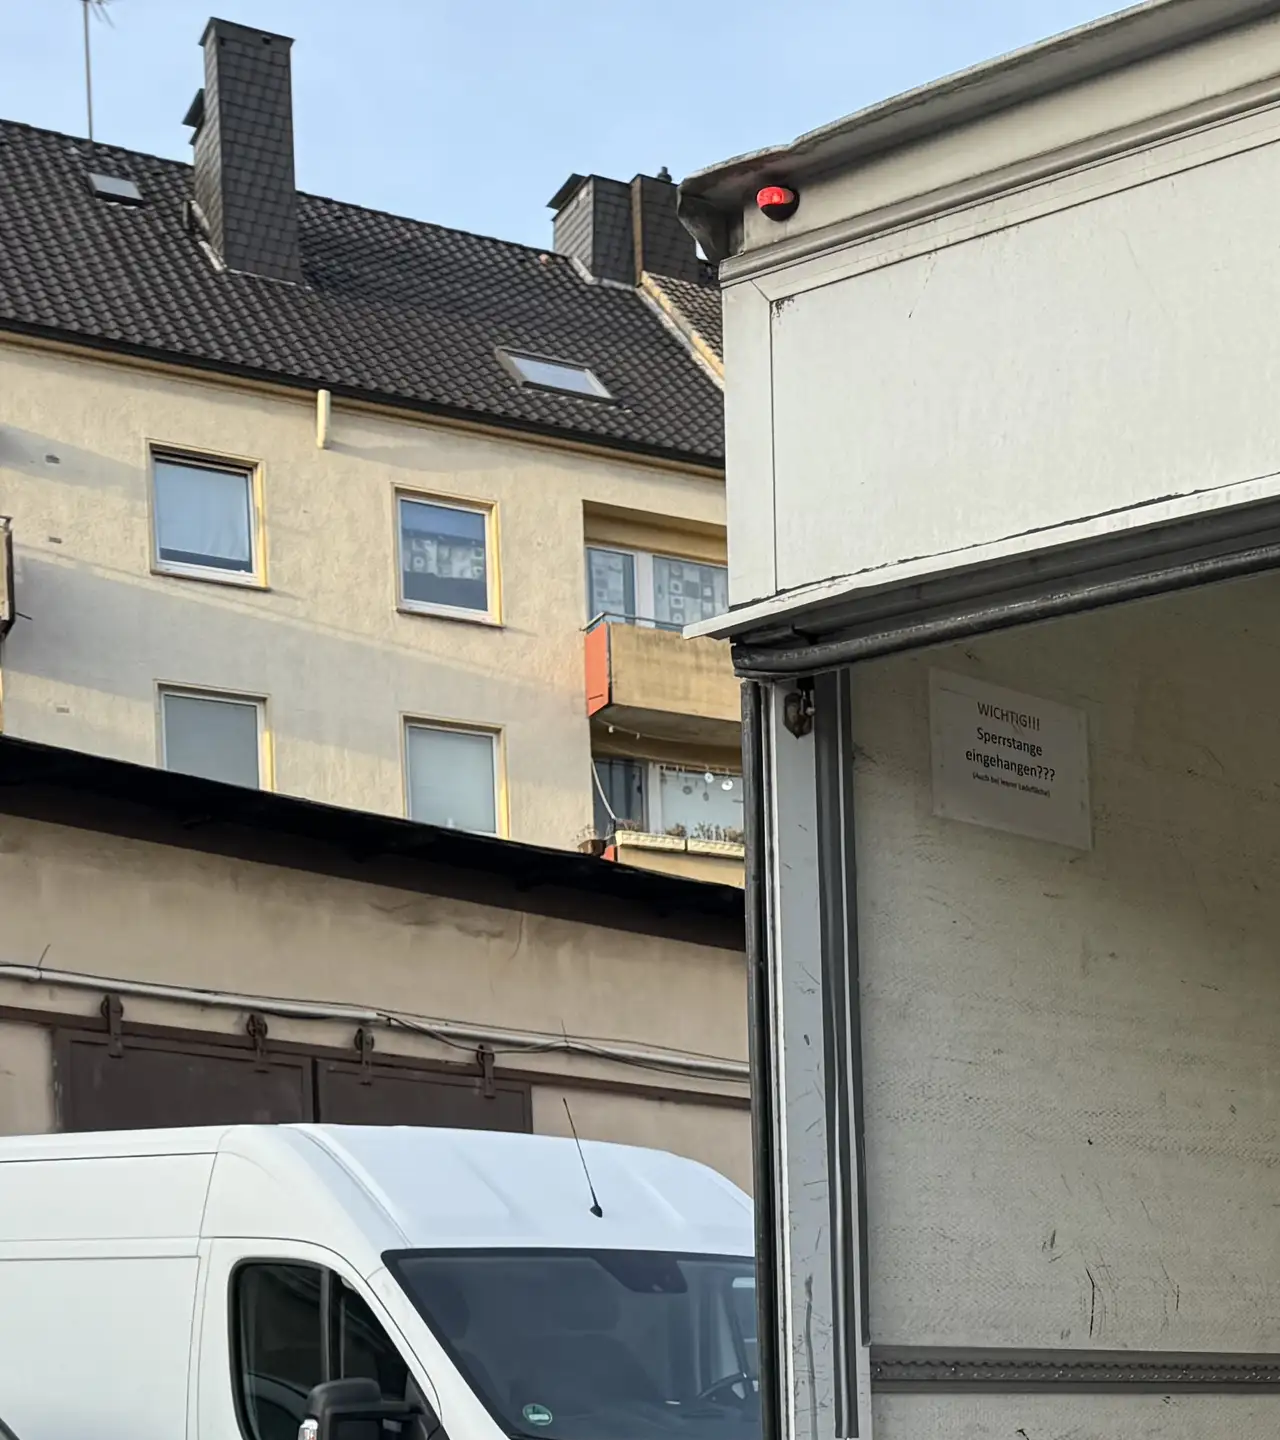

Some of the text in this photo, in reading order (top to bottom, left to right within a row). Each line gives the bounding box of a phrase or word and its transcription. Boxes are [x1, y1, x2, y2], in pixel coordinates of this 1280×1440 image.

[977, 702, 1040, 731] WICHTIG!!!
[977, 727, 1042, 757] Sperrstange
[966, 749, 1055, 782] eingehangen???
